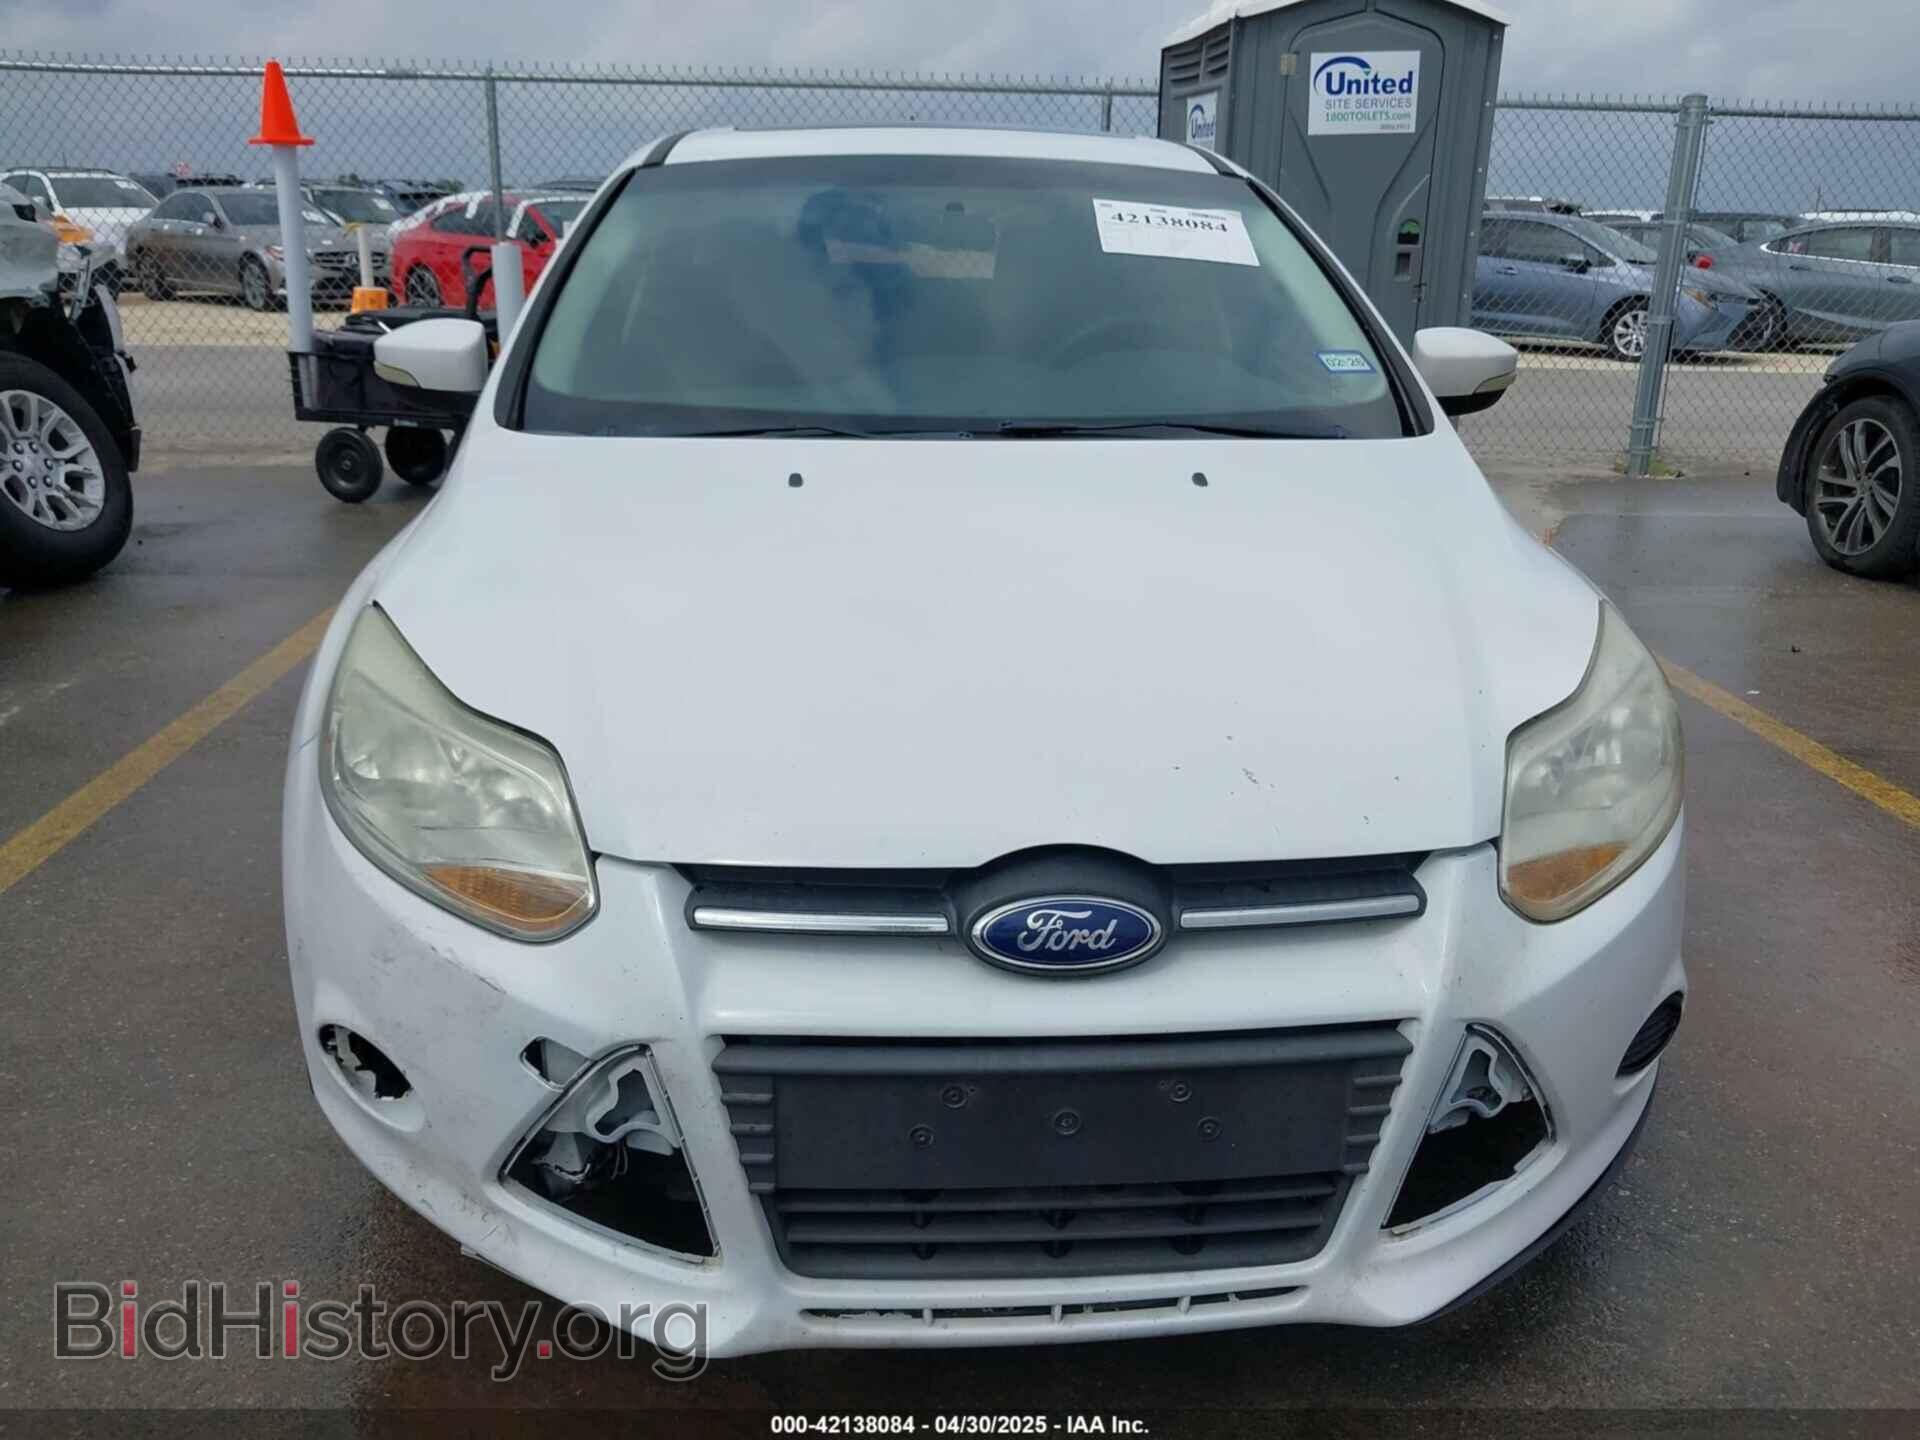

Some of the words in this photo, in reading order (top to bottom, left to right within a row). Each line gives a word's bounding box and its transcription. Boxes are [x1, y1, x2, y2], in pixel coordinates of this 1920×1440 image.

[1326, 70, 1413, 95] United
[1325, 99, 1351, 109] SITE
[1355, 97, 1412, 109] SERVICES
[1326, 111, 1411, 122] 1800TOILETS.com
[1111, 212, 1228, 232] 42138084
[1017, 909, 1118, 951] Ford
